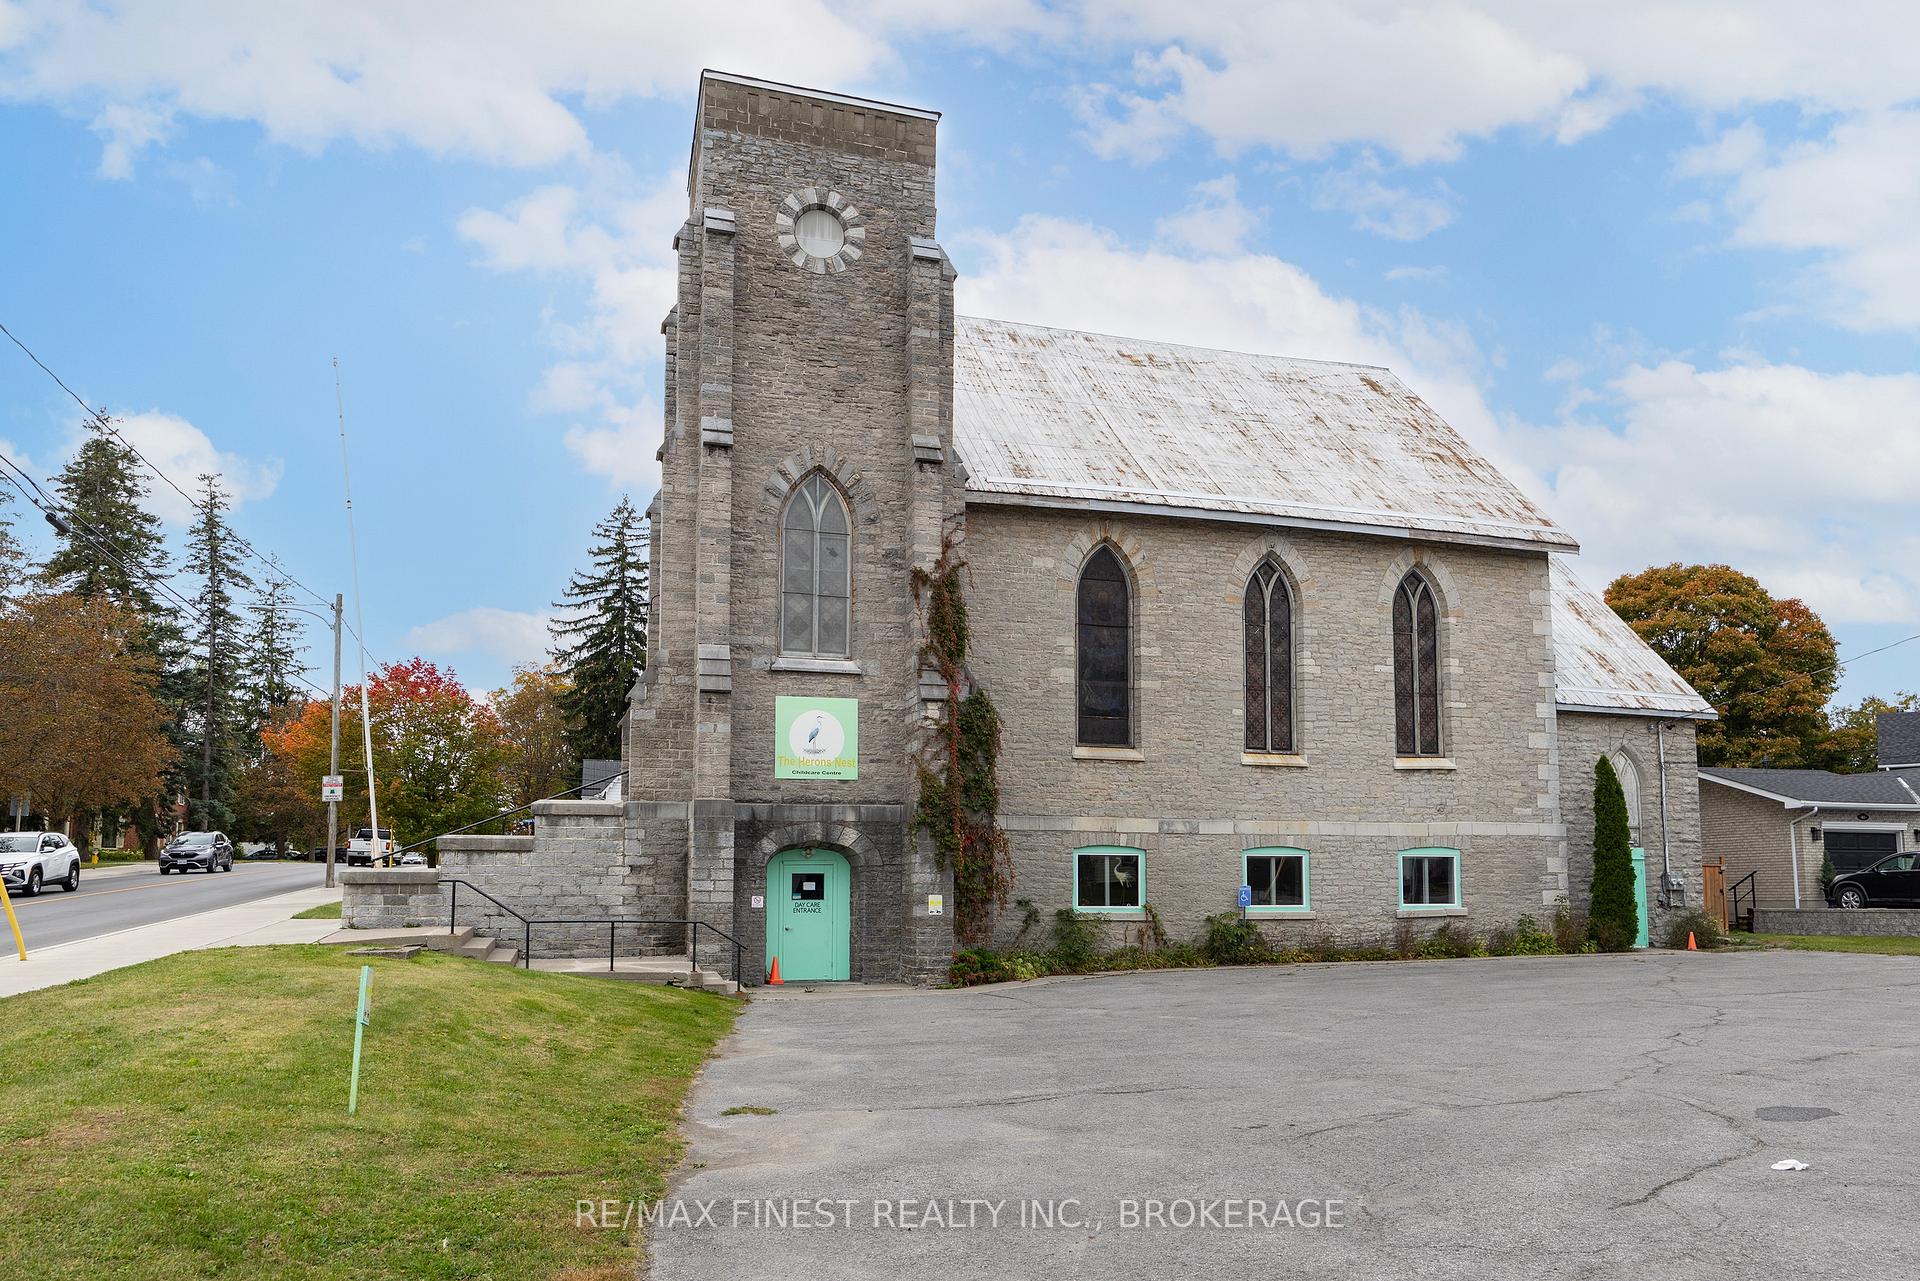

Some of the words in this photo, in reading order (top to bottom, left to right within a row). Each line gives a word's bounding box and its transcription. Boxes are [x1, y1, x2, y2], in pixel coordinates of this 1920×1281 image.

[778, 756, 795, 768] The
[798, 756, 832, 768] Herons
[834, 758, 856, 769] Nest
